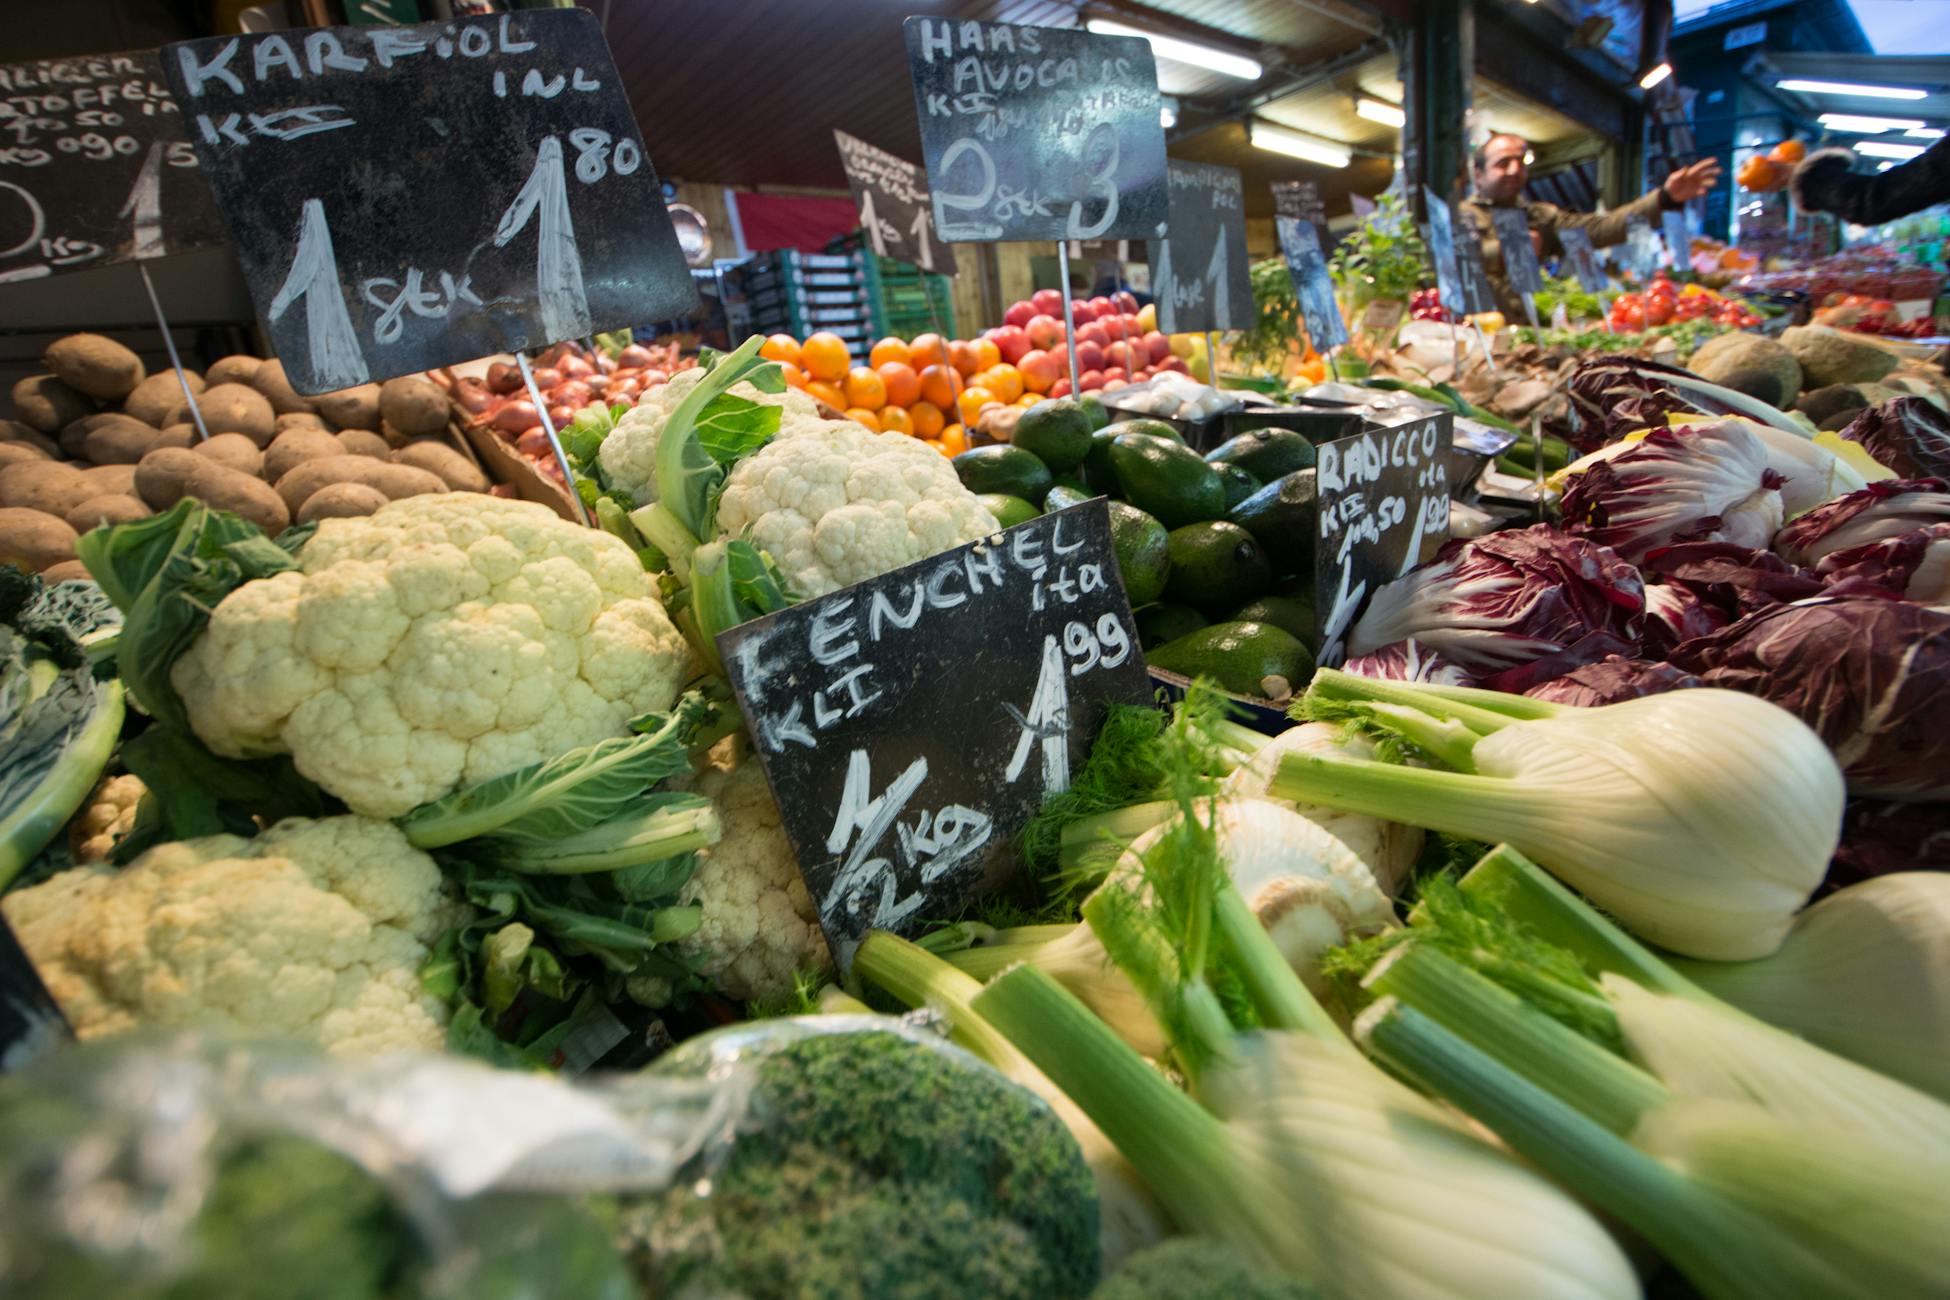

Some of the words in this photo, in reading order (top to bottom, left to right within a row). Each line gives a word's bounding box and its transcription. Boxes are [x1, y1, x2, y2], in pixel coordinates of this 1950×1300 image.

[493, 68, 600, 99] INL
[267, 198, 370, 391] 1
[1317, 420, 1438, 497] RADICCO
[735, 517, 1088, 703] FENCHEL
[757, 663, 884, 753] KLI
